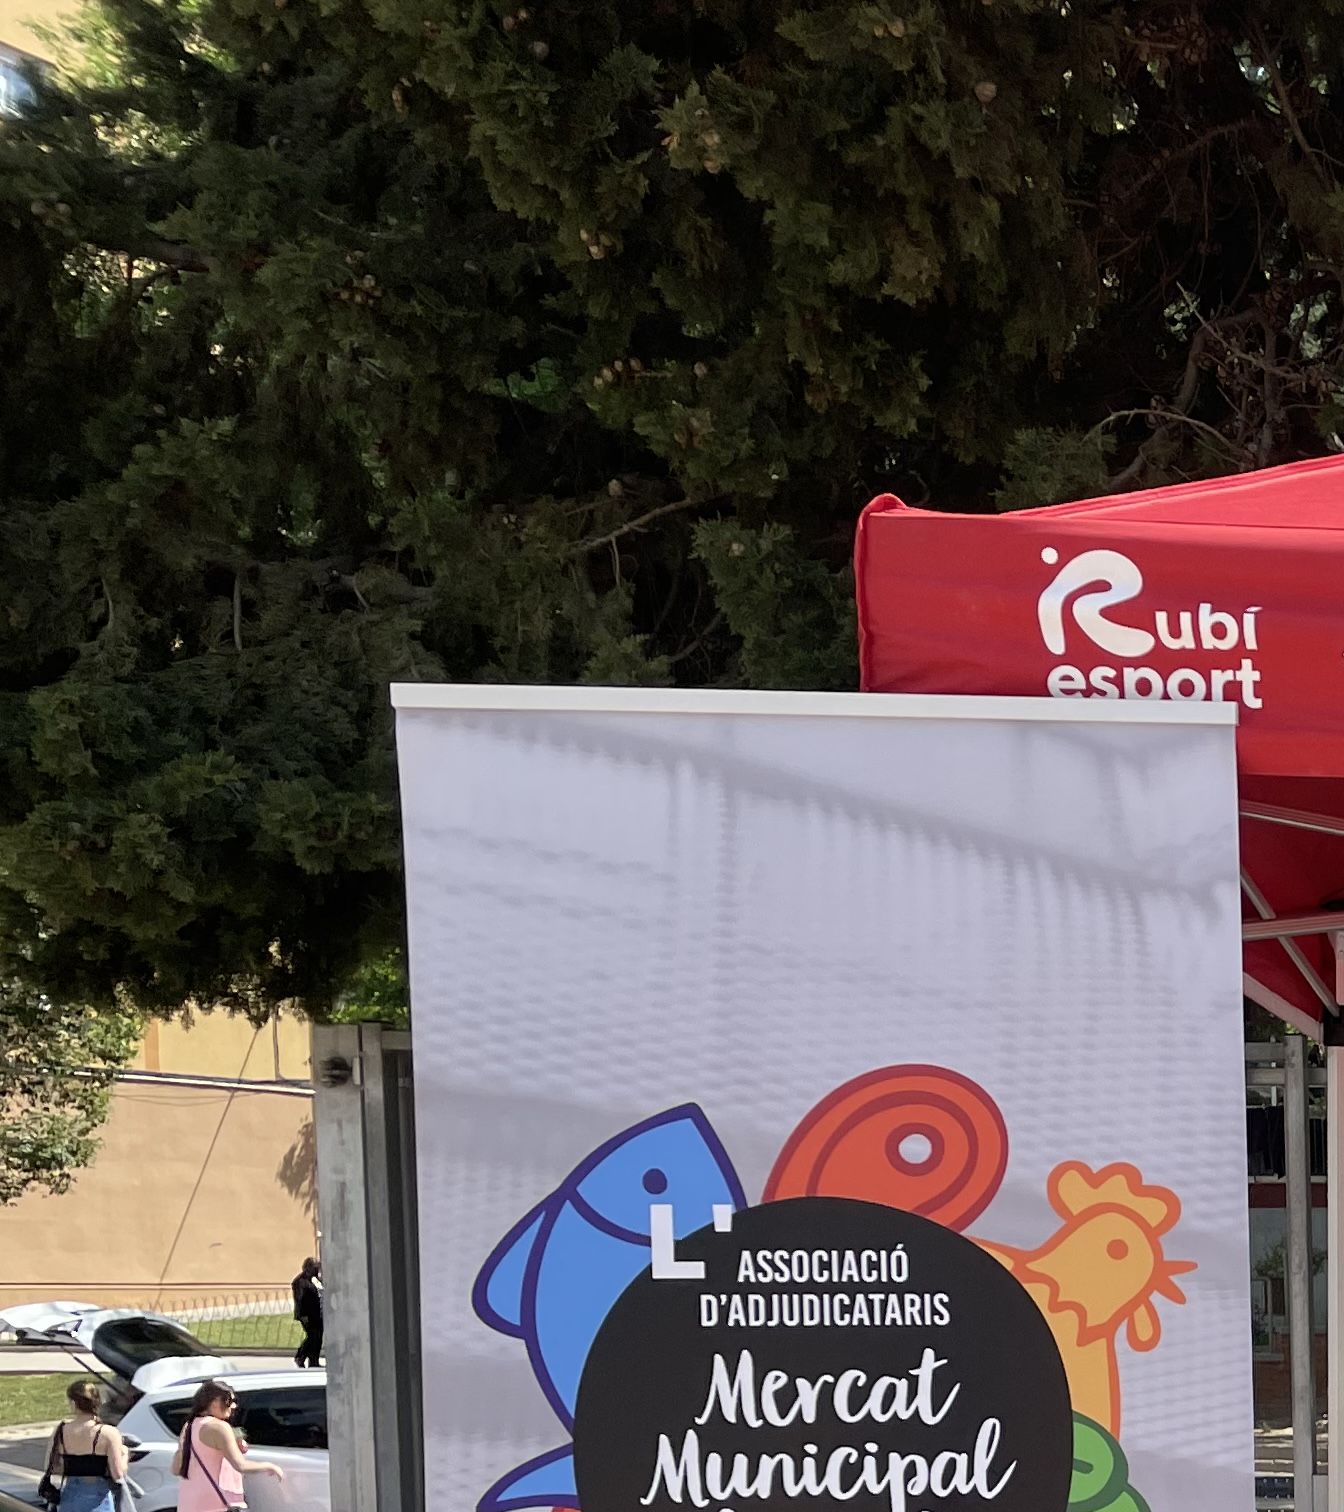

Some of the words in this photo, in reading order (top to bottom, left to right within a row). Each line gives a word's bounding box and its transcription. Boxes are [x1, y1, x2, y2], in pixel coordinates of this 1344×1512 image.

[1037, 546, 1263, 658] Rubí
[1046, 658, 1263, 710] esport
[737, 1243, 909, 1283] ASSOCIACIÓ
[700, 1292, 951, 1327] D'ADJUDICATARIS
[694, 1347, 961, 1428] Mercat
